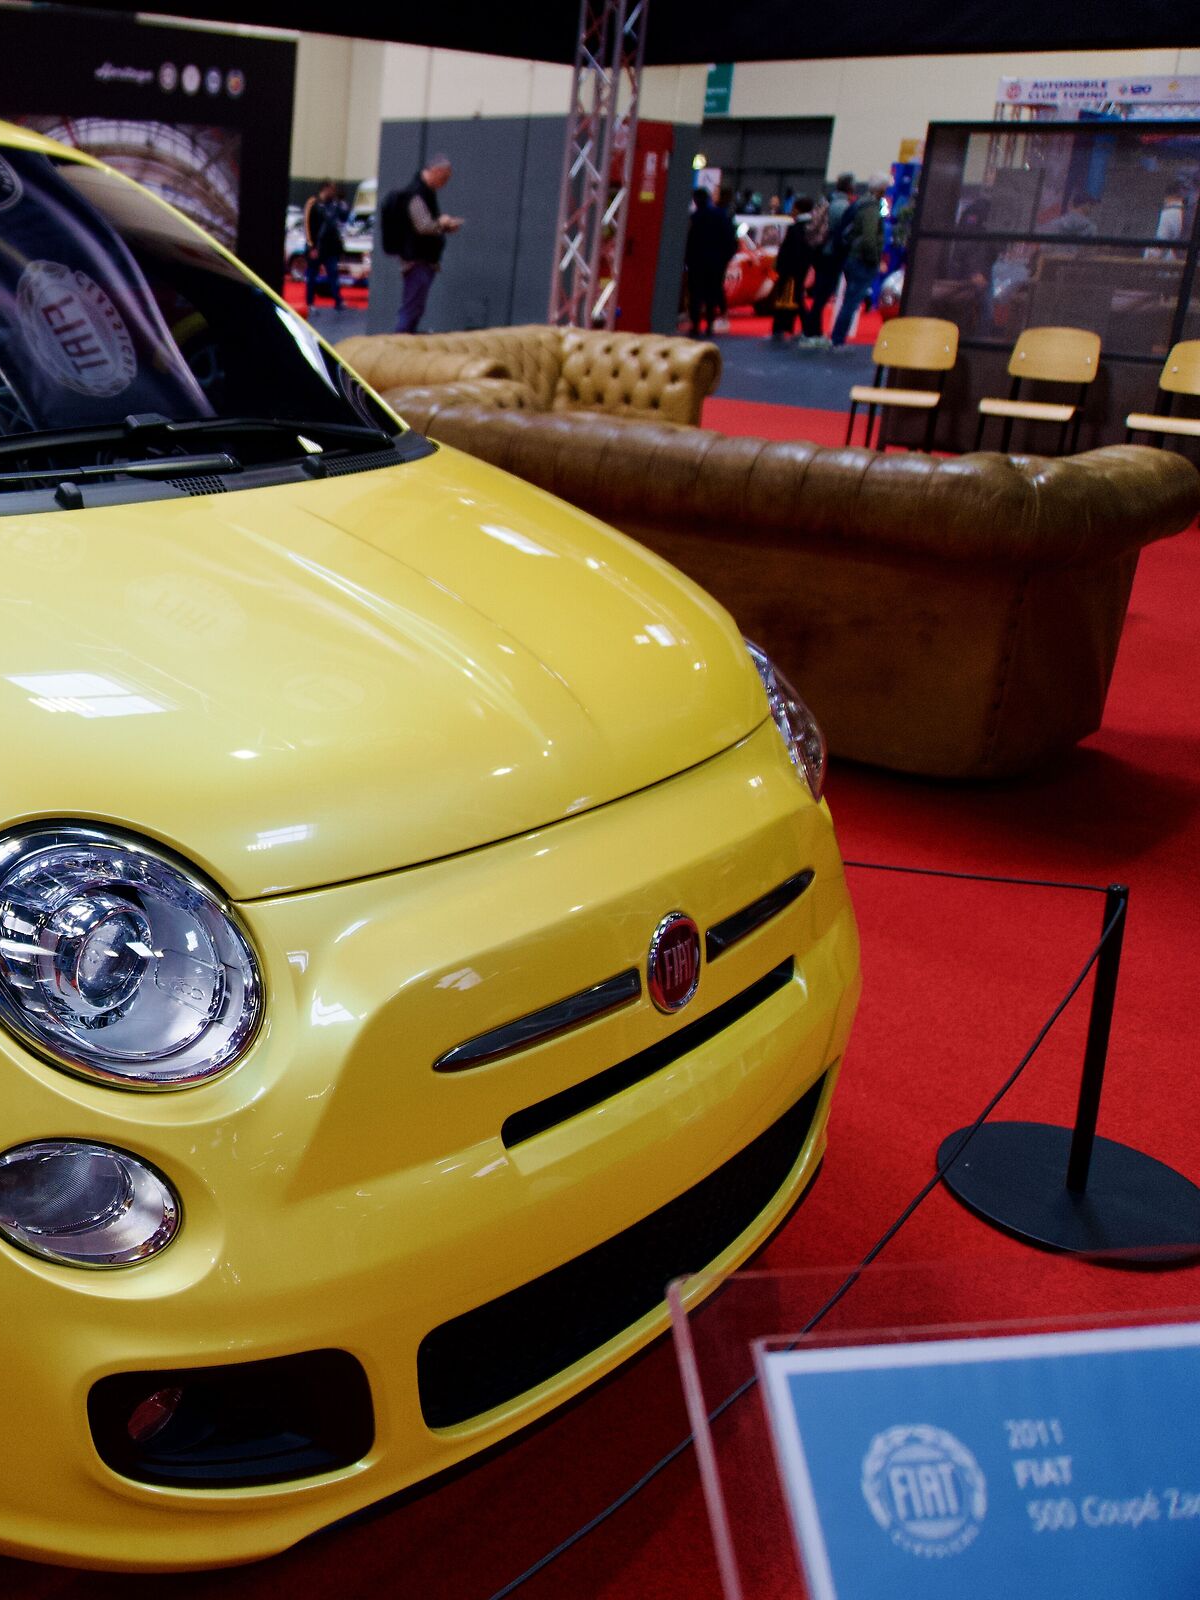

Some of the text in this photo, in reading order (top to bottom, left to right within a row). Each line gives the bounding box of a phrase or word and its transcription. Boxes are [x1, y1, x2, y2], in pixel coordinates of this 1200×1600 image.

[1032, 80, 1109, 90] AUTOMOBILE
[664, 938, 692, 991] FIAT
[1005, 1419, 1064, 1448] 2011
[1013, 1456, 1073, 1489] FIAT
[889, 1462, 959, 1520] FIAT
[1027, 1497, 1078, 1532] 500
